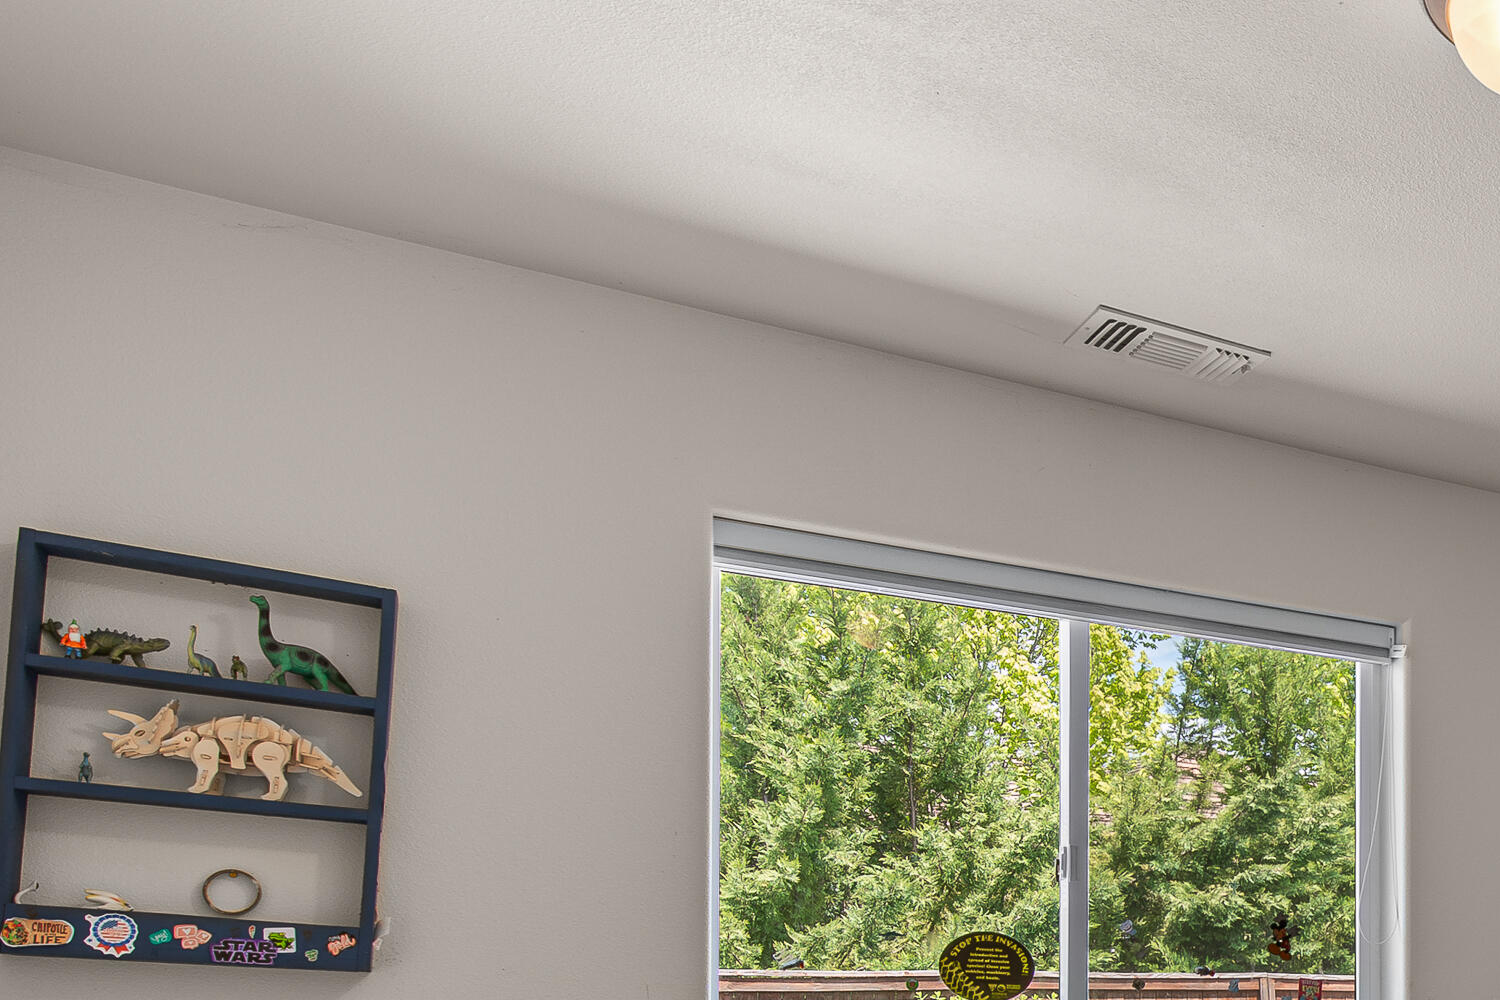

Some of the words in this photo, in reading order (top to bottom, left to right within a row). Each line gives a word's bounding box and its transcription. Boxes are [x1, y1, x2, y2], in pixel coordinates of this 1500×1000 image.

[32, 921, 68, 935] CHIPOTLE
[33, 935, 66, 944] LIFE
[213, 939, 278, 952] STAR
[213, 950, 277, 964] WARS
